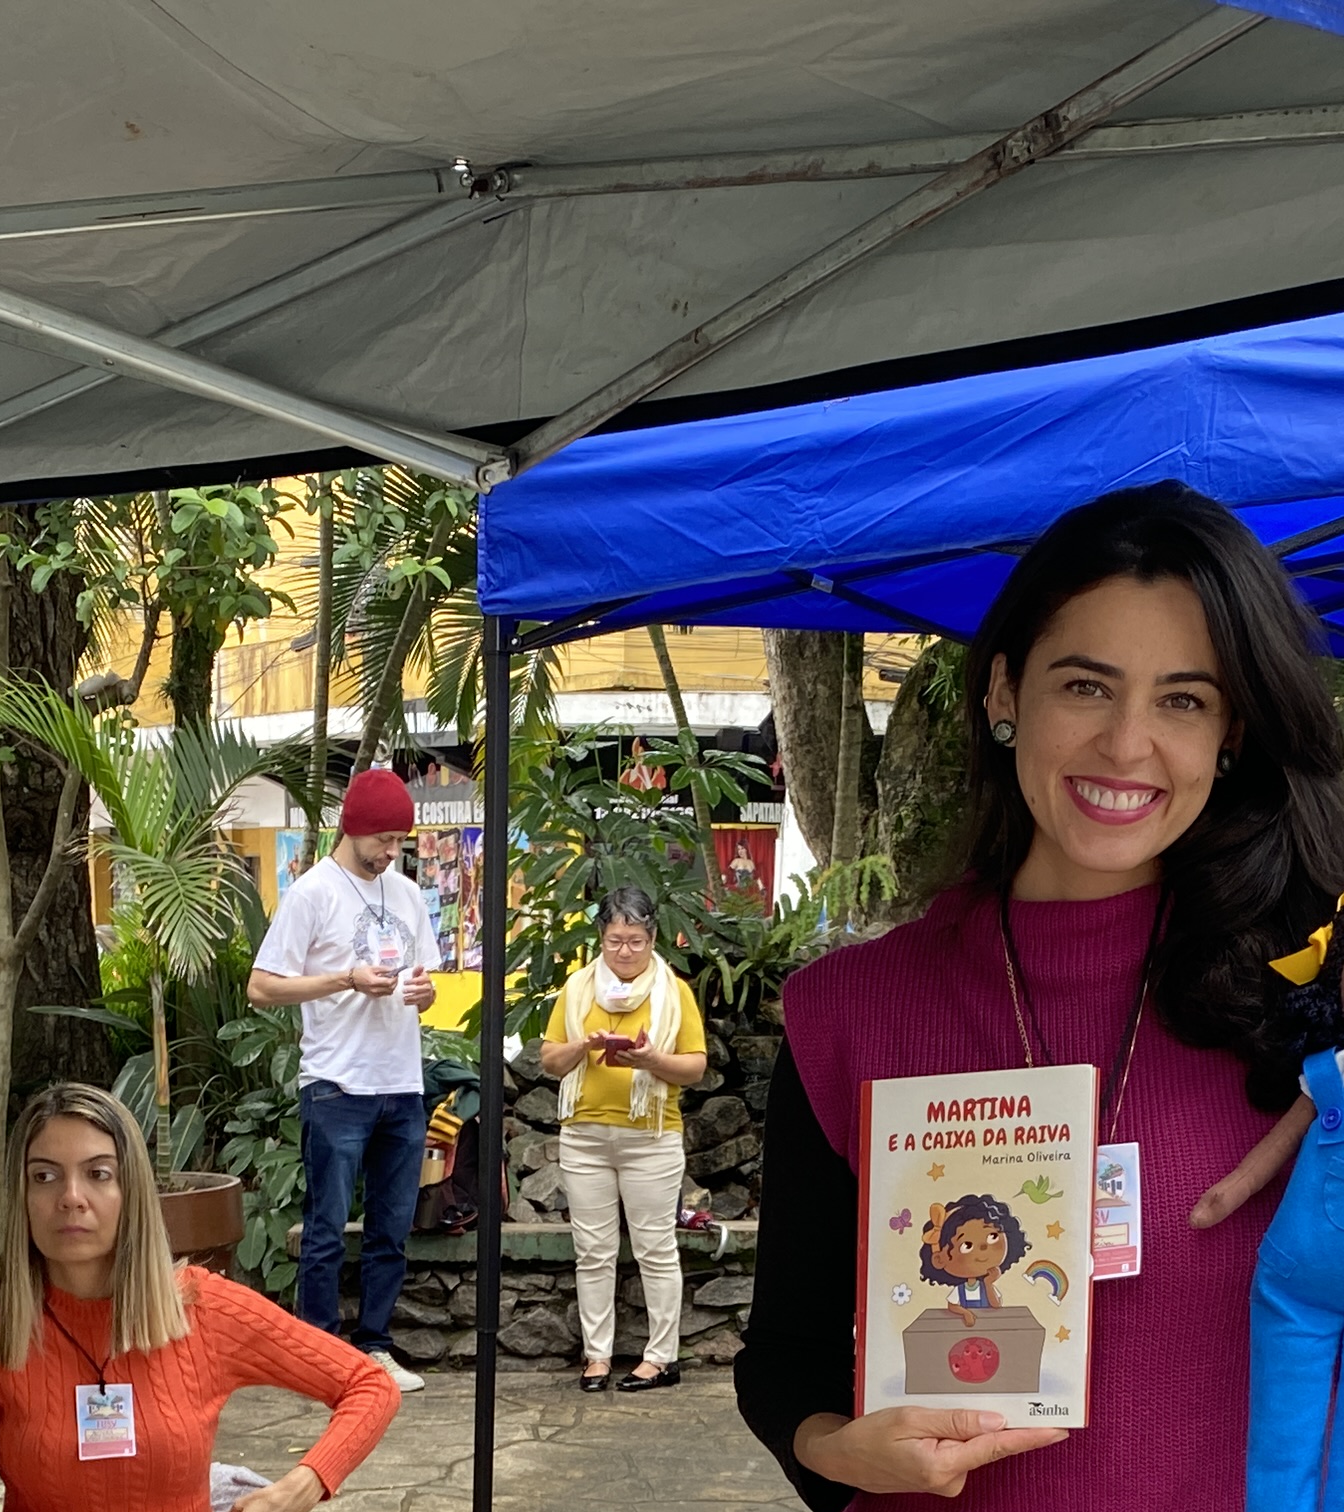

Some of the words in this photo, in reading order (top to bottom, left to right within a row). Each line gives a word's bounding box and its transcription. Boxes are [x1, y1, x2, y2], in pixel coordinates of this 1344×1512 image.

[422, 800, 472, 825] COSTURA
[927, 1095, 1032, 1124] MARTINA
[888, 1133, 899, 1151] E
[904, 1133, 916, 1151] A
[922, 1129, 976, 1151] CAIXA
[983, 1127, 1007, 1147] DA
[1014, 1123, 1071, 1146] RAIVA
[982, 1154, 1023, 1165] Marina
[1027, 1150, 1071, 1163] Oliveira
